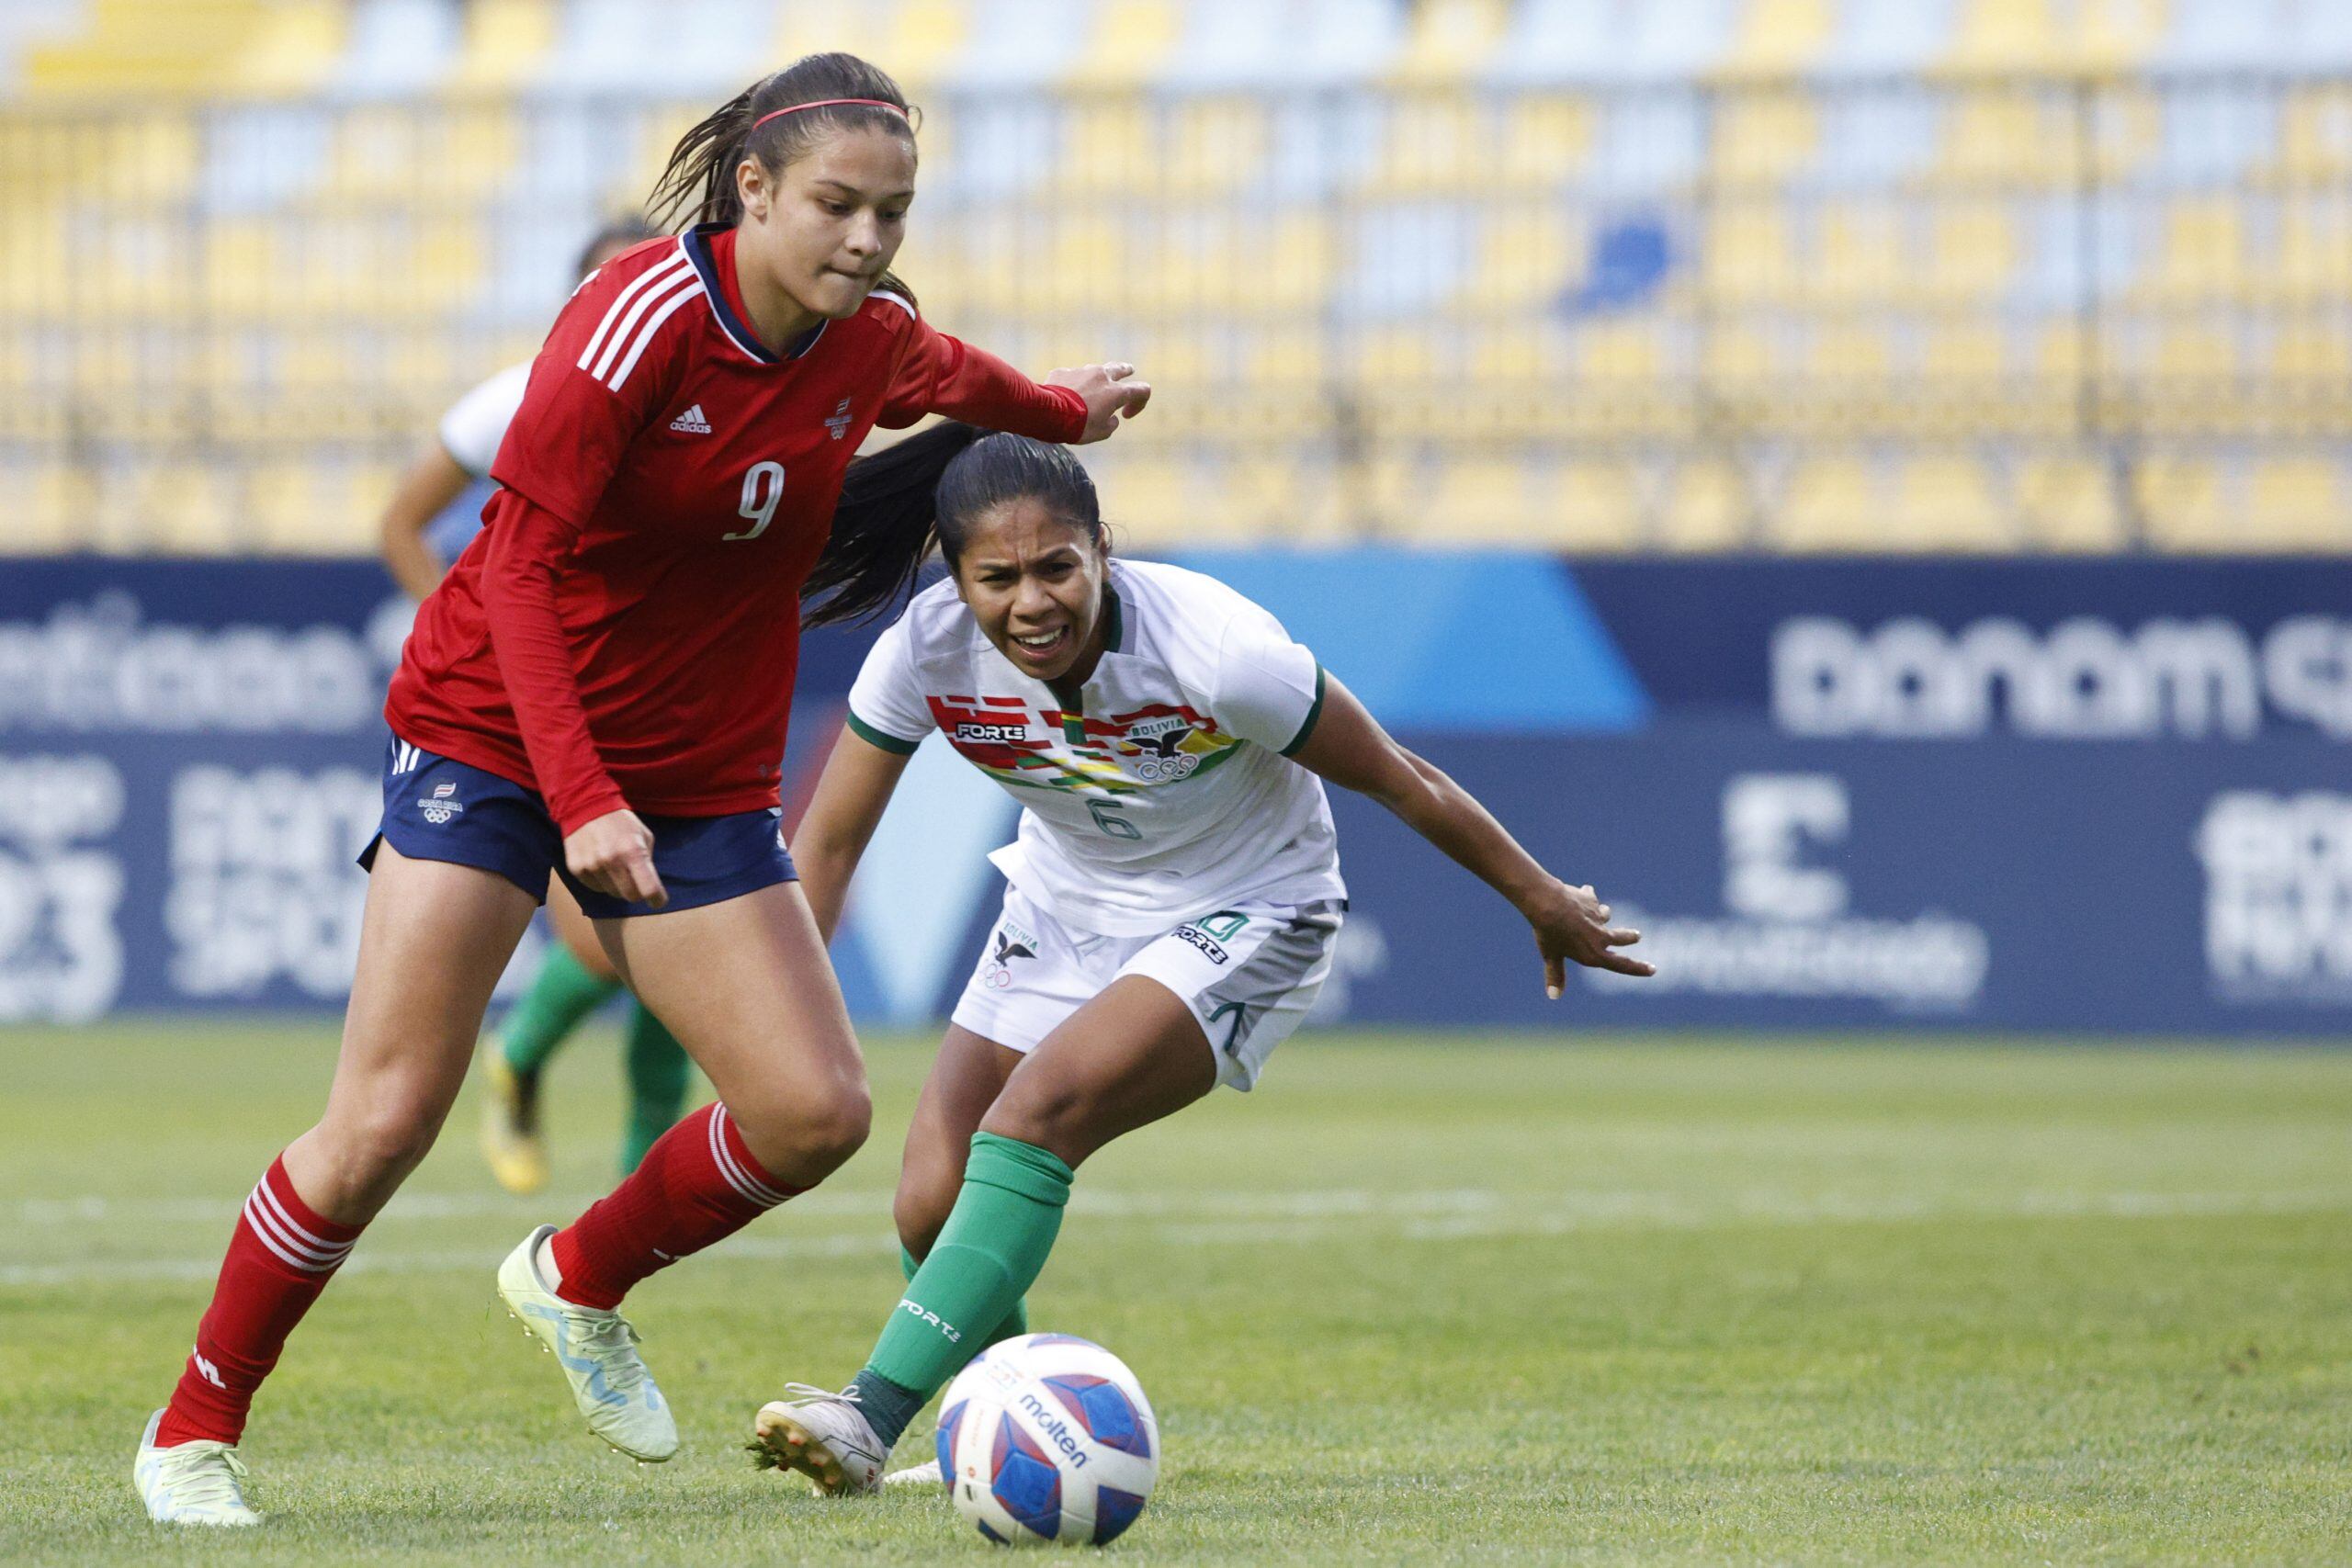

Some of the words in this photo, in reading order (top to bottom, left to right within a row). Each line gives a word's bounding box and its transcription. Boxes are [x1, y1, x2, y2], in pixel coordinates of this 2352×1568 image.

[670, 422, 712, 434] adidas
[722, 461, 785, 540] 9
[956, 722, 1025, 740] FORTE
[1131, 718, 1186, 736] BOLIVIA
[1084, 797, 1143, 840] 6
[898, 1298, 962, 1343] FORTE
[1019, 1393, 1088, 1470] molten
